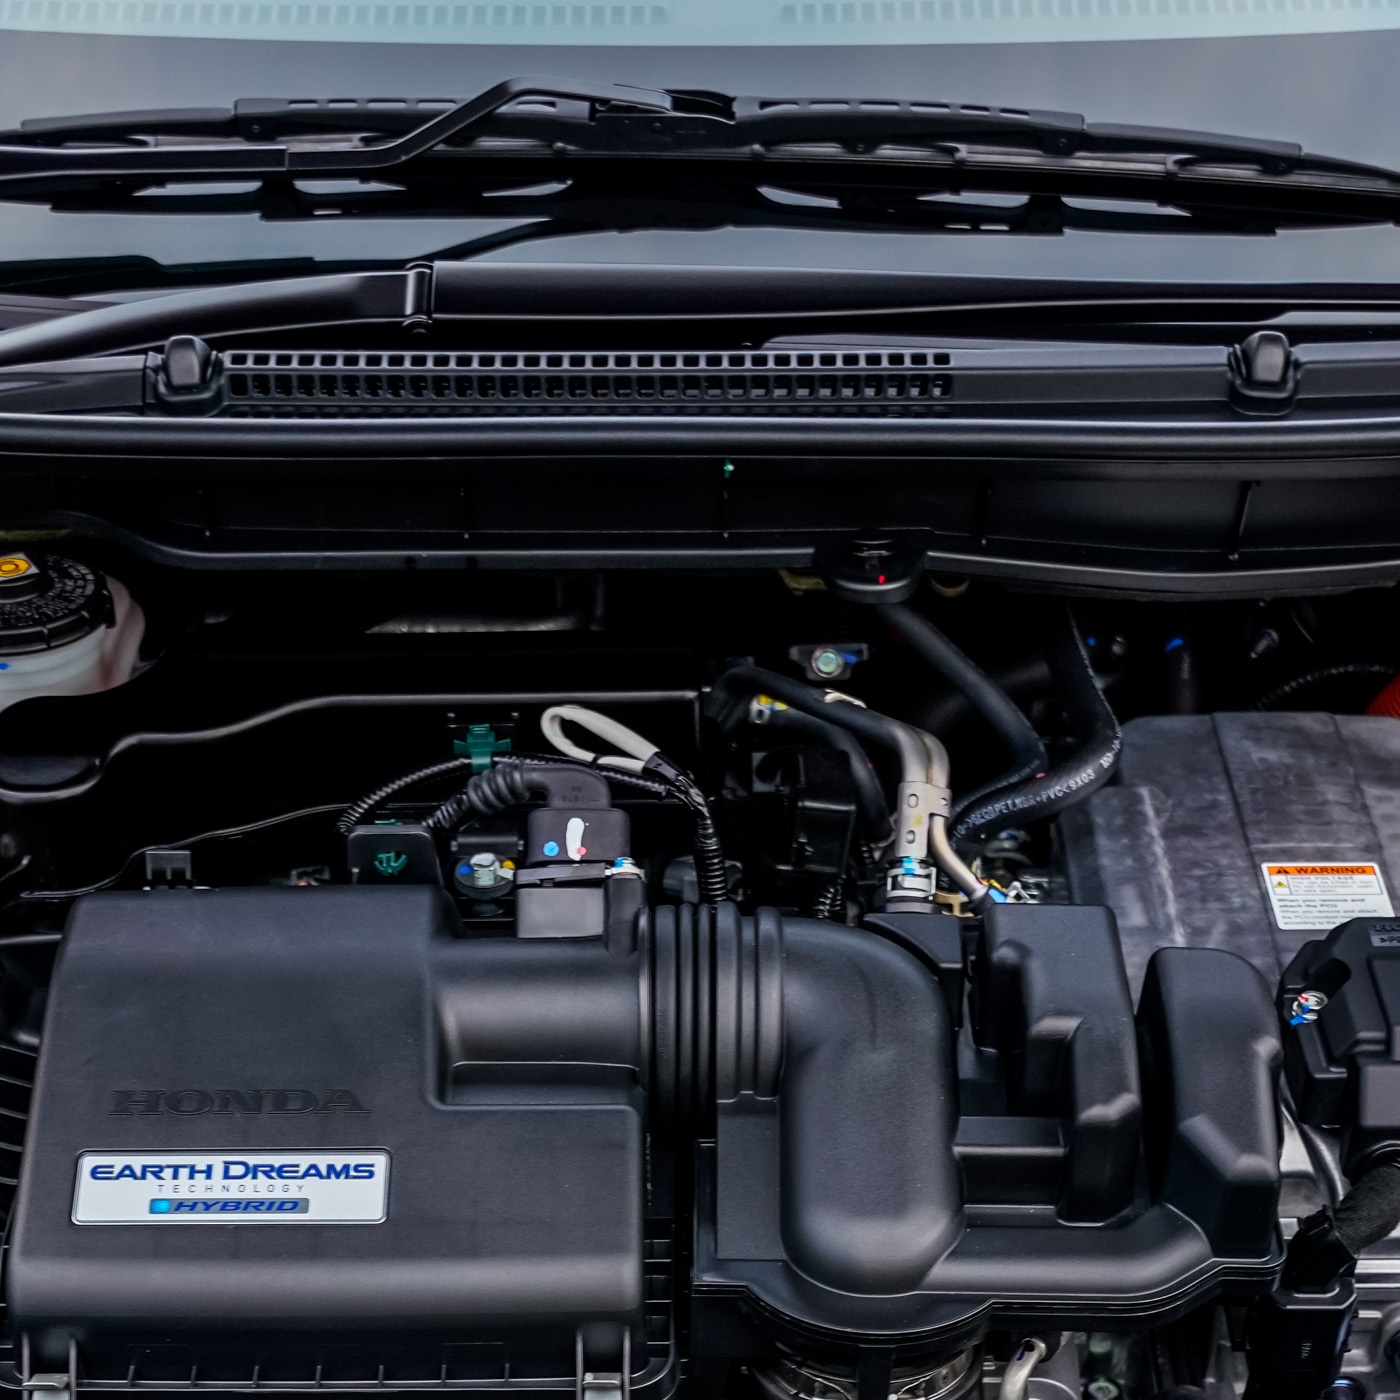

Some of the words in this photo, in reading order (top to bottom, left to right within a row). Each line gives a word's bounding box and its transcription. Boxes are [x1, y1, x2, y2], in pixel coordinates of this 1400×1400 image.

[109, 1089, 371, 1117] HONDA
[90, 1163, 213, 1181] EARTH
[222, 1160, 375, 1181] DREAMS
[157, 1184, 305, 1193] TECHNOLOGY
[173, 1200, 299, 1212] HYBRID
